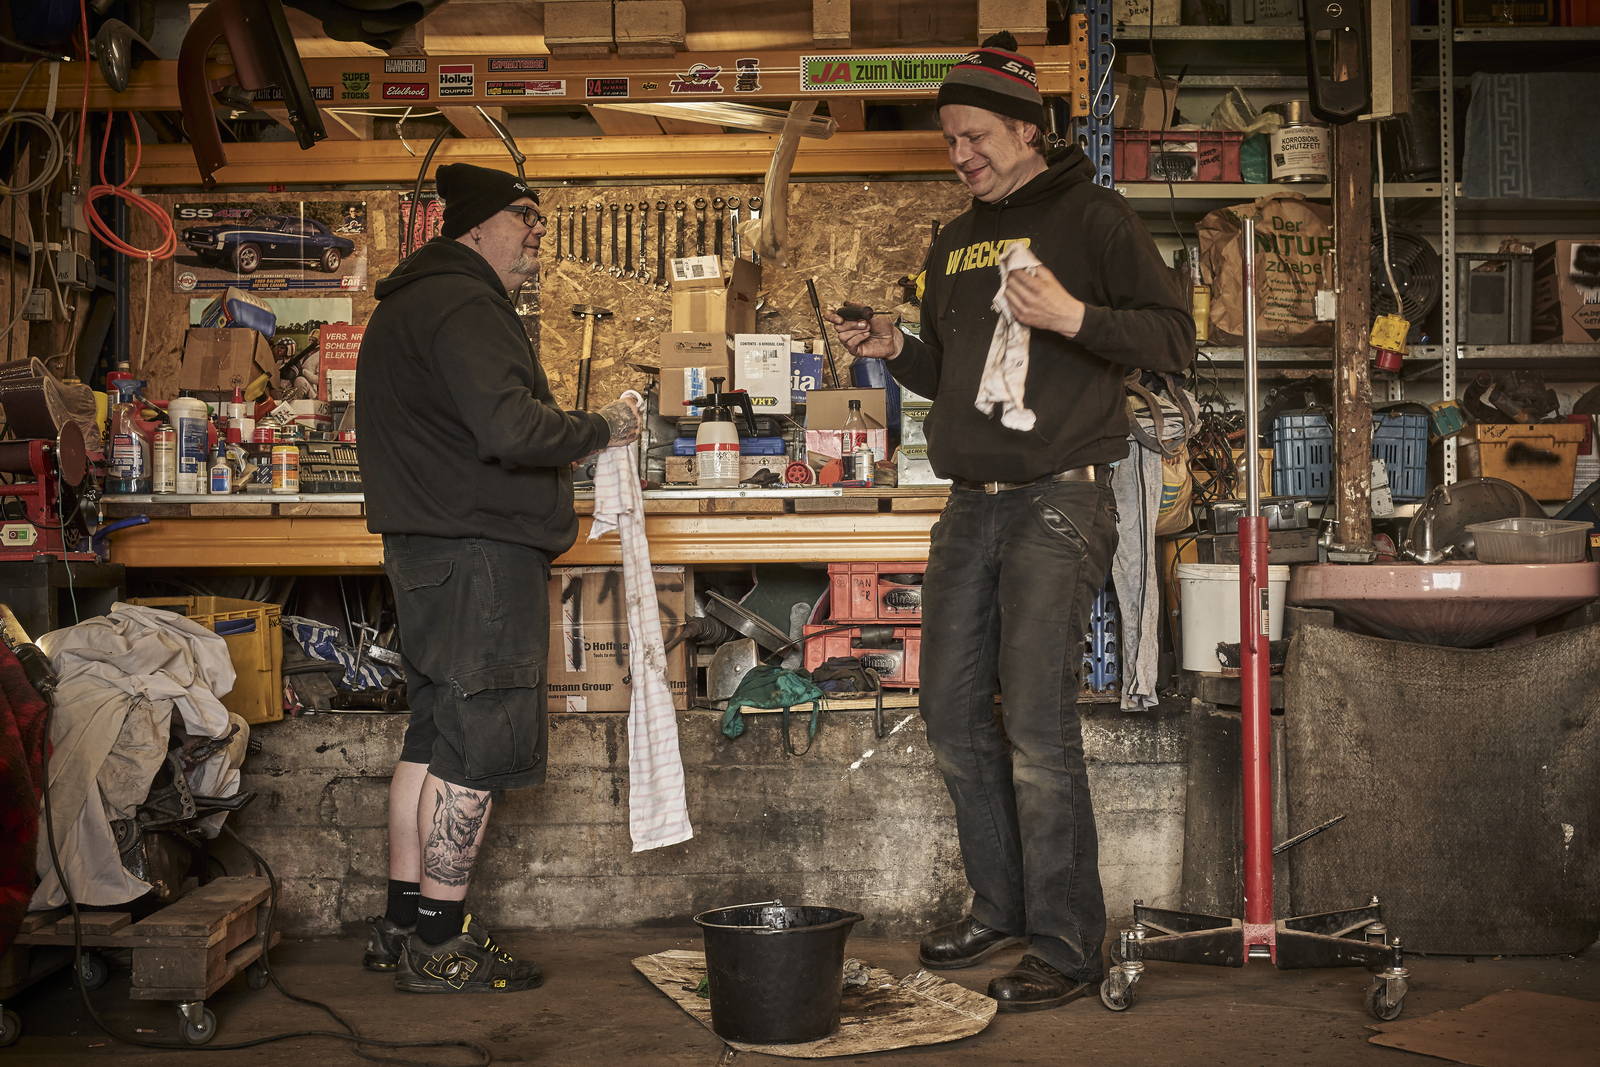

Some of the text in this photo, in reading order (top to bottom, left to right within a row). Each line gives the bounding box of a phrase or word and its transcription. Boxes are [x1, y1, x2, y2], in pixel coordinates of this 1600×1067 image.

[385, 60, 425, 73] HAMMERHEAD
[342, 73, 370, 81] SUPER
[811, 63, 852, 83] JA
[855, 65, 888, 81] zum
[1001, 60, 1038, 87] Sna
[439, 75, 473, 86] Holley
[386, 86, 426, 97] Edelbrock
[587, 80, 601, 95] 24
[341, 91, 370, 100] STOCKS
[1281, 143, 1321, 152] SCHUTZFETT
[180, 208, 213, 219] SS
[1271, 215, 1303, 233] Der
[751, 396, 774, 405] VHT
[547, 682, 613, 692] fmann Group
